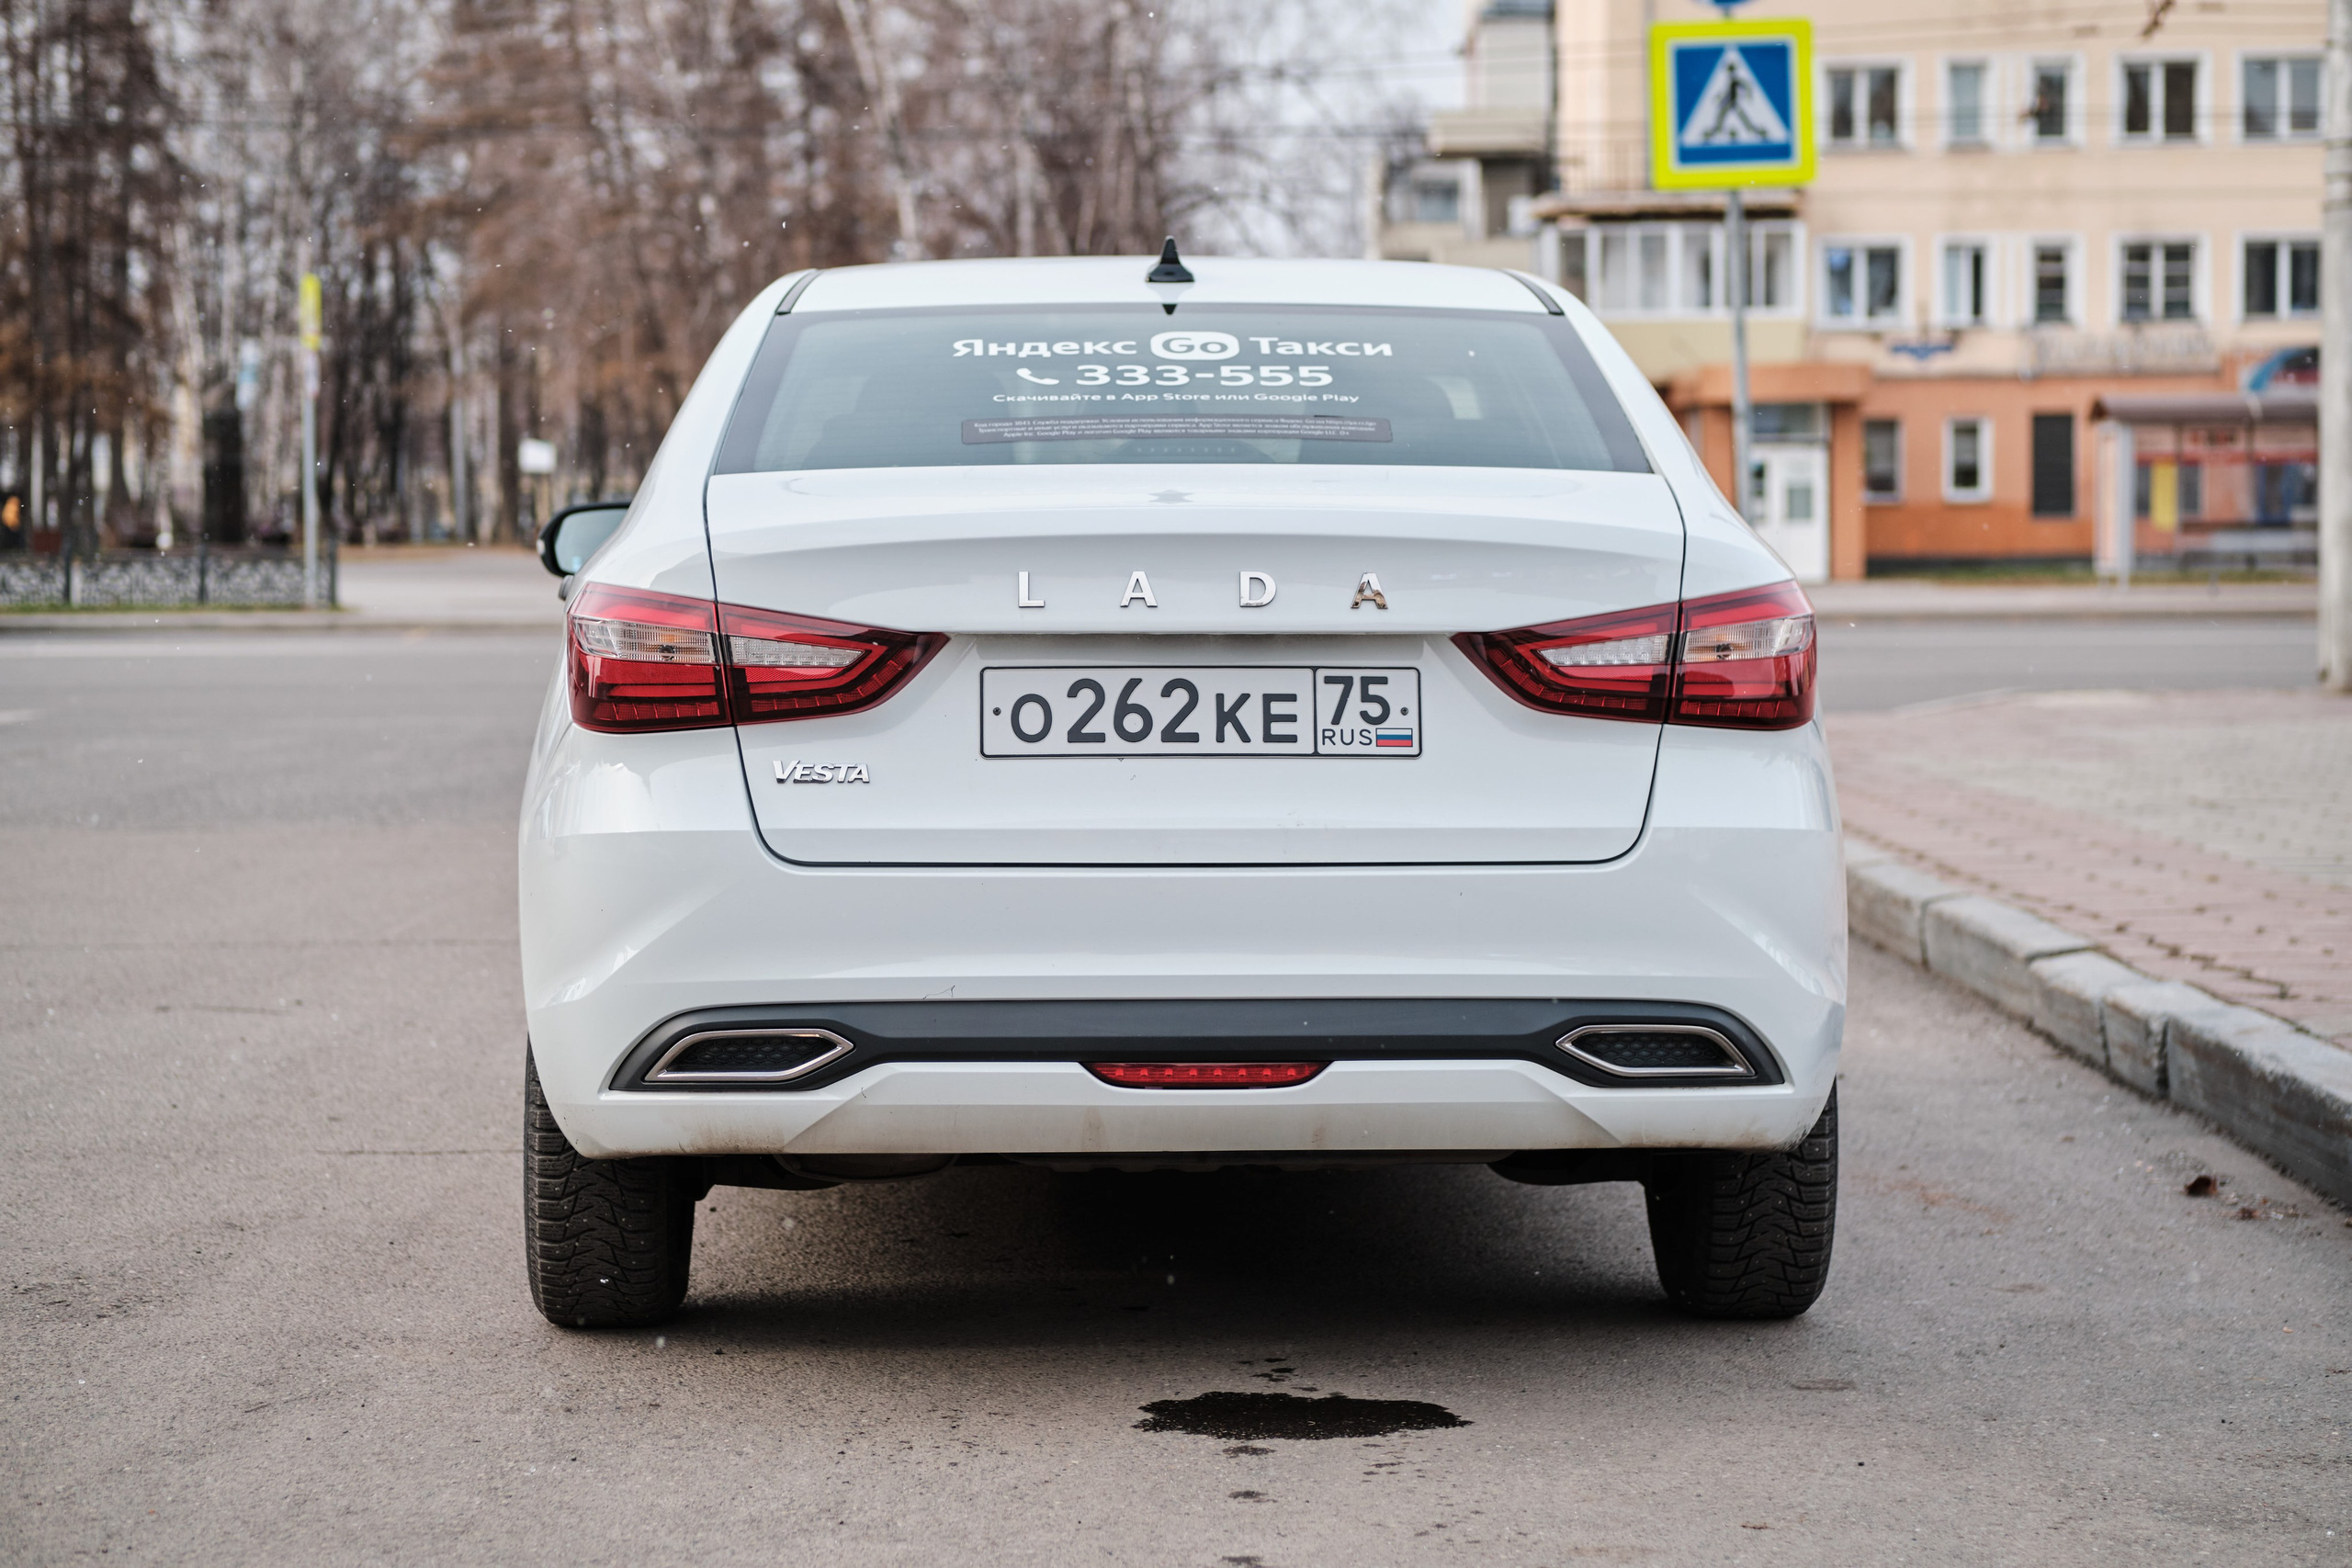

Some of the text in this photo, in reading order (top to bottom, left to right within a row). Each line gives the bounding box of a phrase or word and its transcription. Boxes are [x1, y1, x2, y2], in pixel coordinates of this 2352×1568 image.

[952, 337, 1393, 357] Яндекс Go Такси
[1076, 365, 1333, 386] 333-555
[992, 393, 1102, 402] Скачивайте
[1121, 392, 1159, 401] App
[1162, 392, 1211, 401] Store
[1253, 392, 1317, 402] Google
[1322, 393, 1359, 402] Play
[1018, 570, 1388, 610] LADA
[1323, 676, 1391, 726] 75
[1322, 728, 1373, 746] RUS
[772, 760, 871, 784] VESTA
